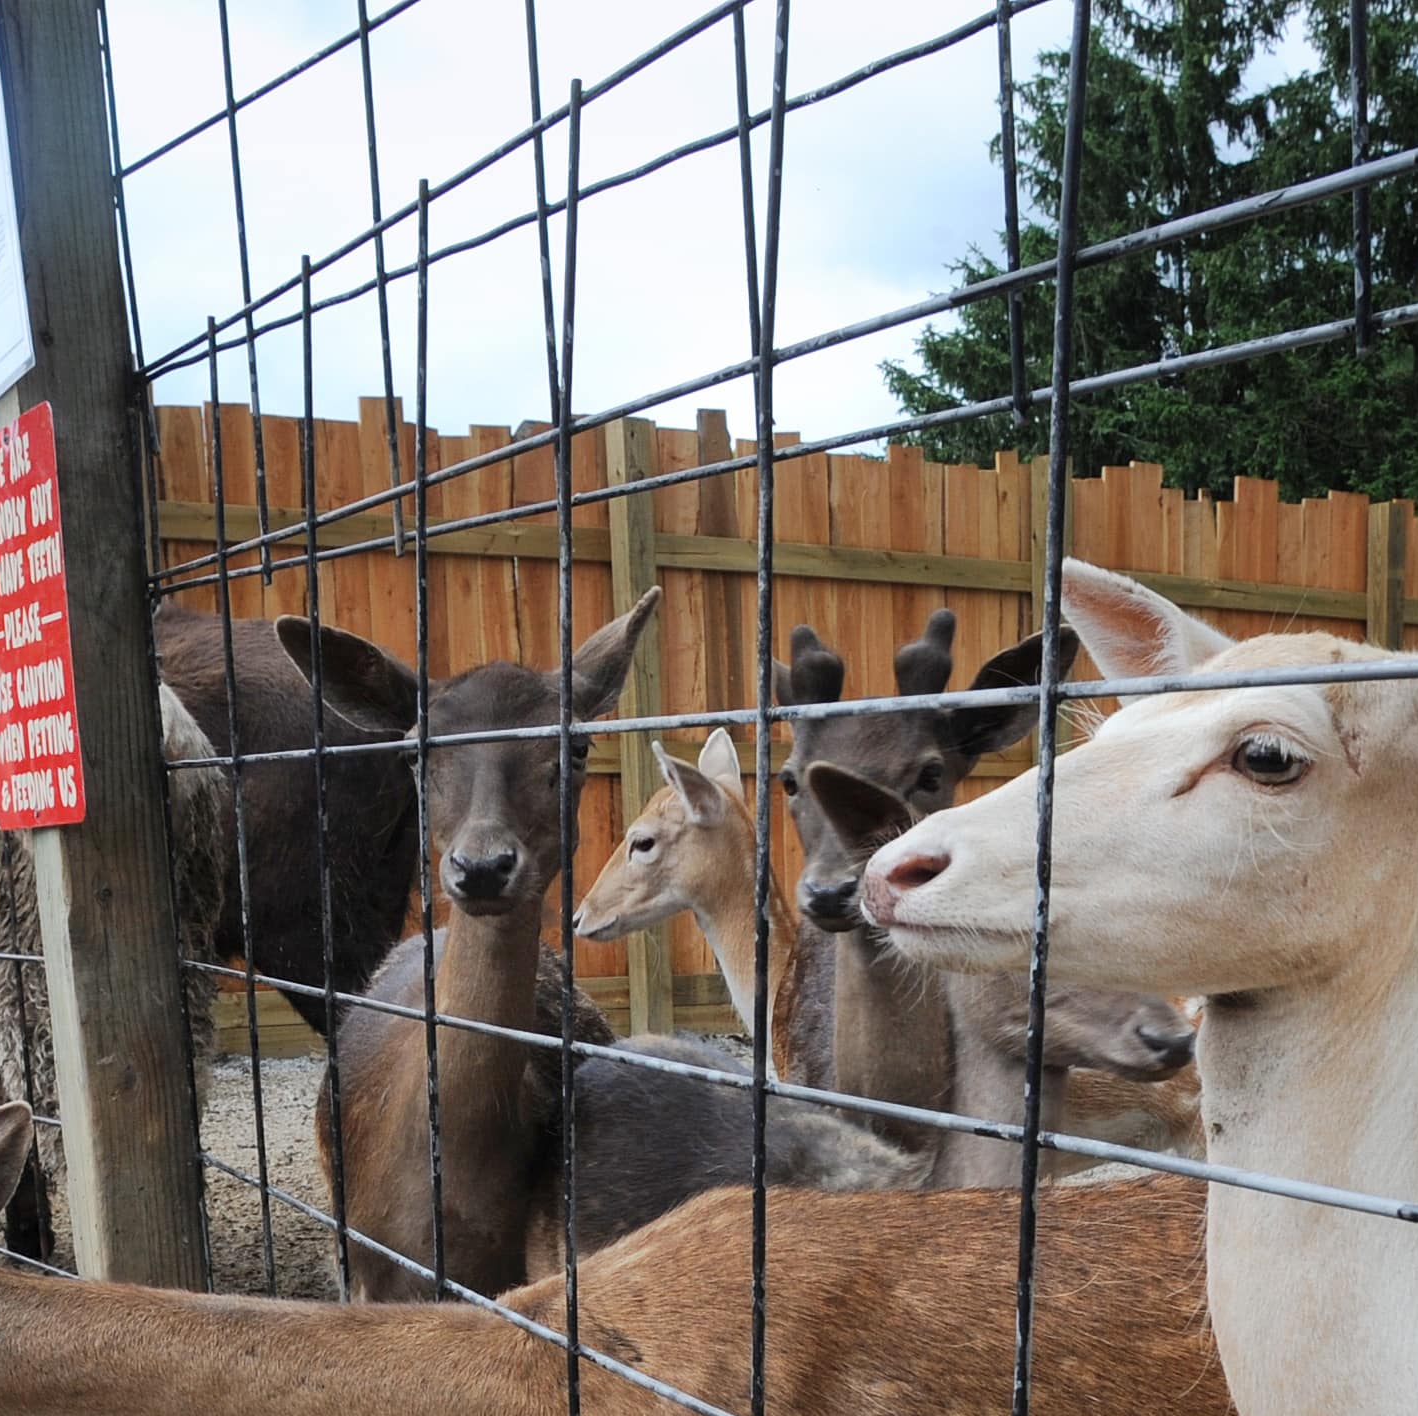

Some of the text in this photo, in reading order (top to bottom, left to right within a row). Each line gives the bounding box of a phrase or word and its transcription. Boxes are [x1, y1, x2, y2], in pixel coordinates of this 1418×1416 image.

[9, 432, 31, 484] ARE
[30, 479, 53, 527] BUT
[28, 532, 61, 584] TEETH
[17, 657, 65, 708] CAUTION
[27, 711, 74, 760] PETTING
[1, 765, 77, 813] & FEEDING US
